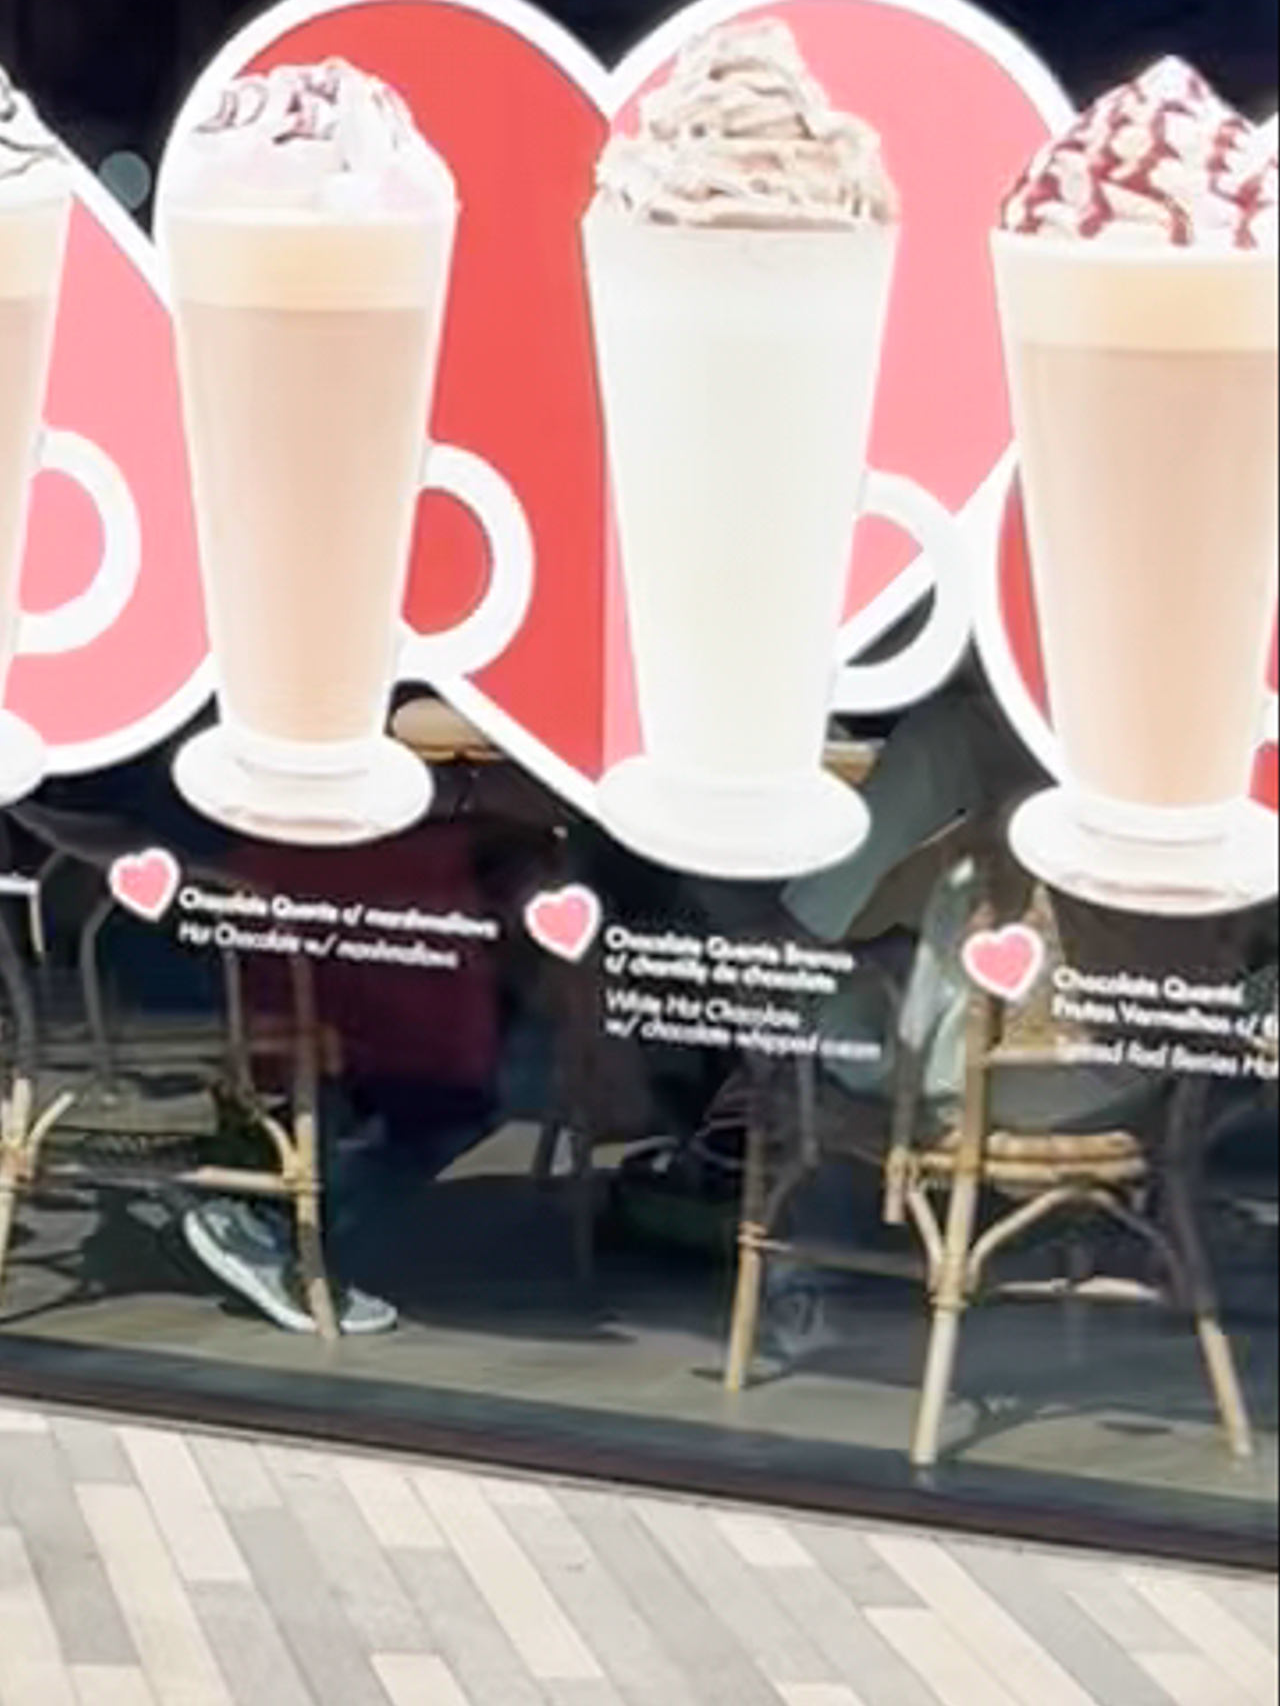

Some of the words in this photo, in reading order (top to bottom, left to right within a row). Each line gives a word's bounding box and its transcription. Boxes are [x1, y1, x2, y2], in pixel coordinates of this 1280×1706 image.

[178, 887, 268, 916] Chocolate
[178, 921, 212, 944] Hot
[214, 923, 300, 953] Chocolate
[604, 926, 703, 957] Chocolate
[706, 936, 780, 964] Quente
[741, 965, 839, 994] chocolate
[1052, 964, 1159, 998] Chocolate
[605, 988, 663, 1014] White
[666, 993, 702, 1019] Hot
[704, 998, 801, 1029] Chocolate
[640, 1021, 732, 1047] chocolate
[733, 1031, 820, 1056] whipped
